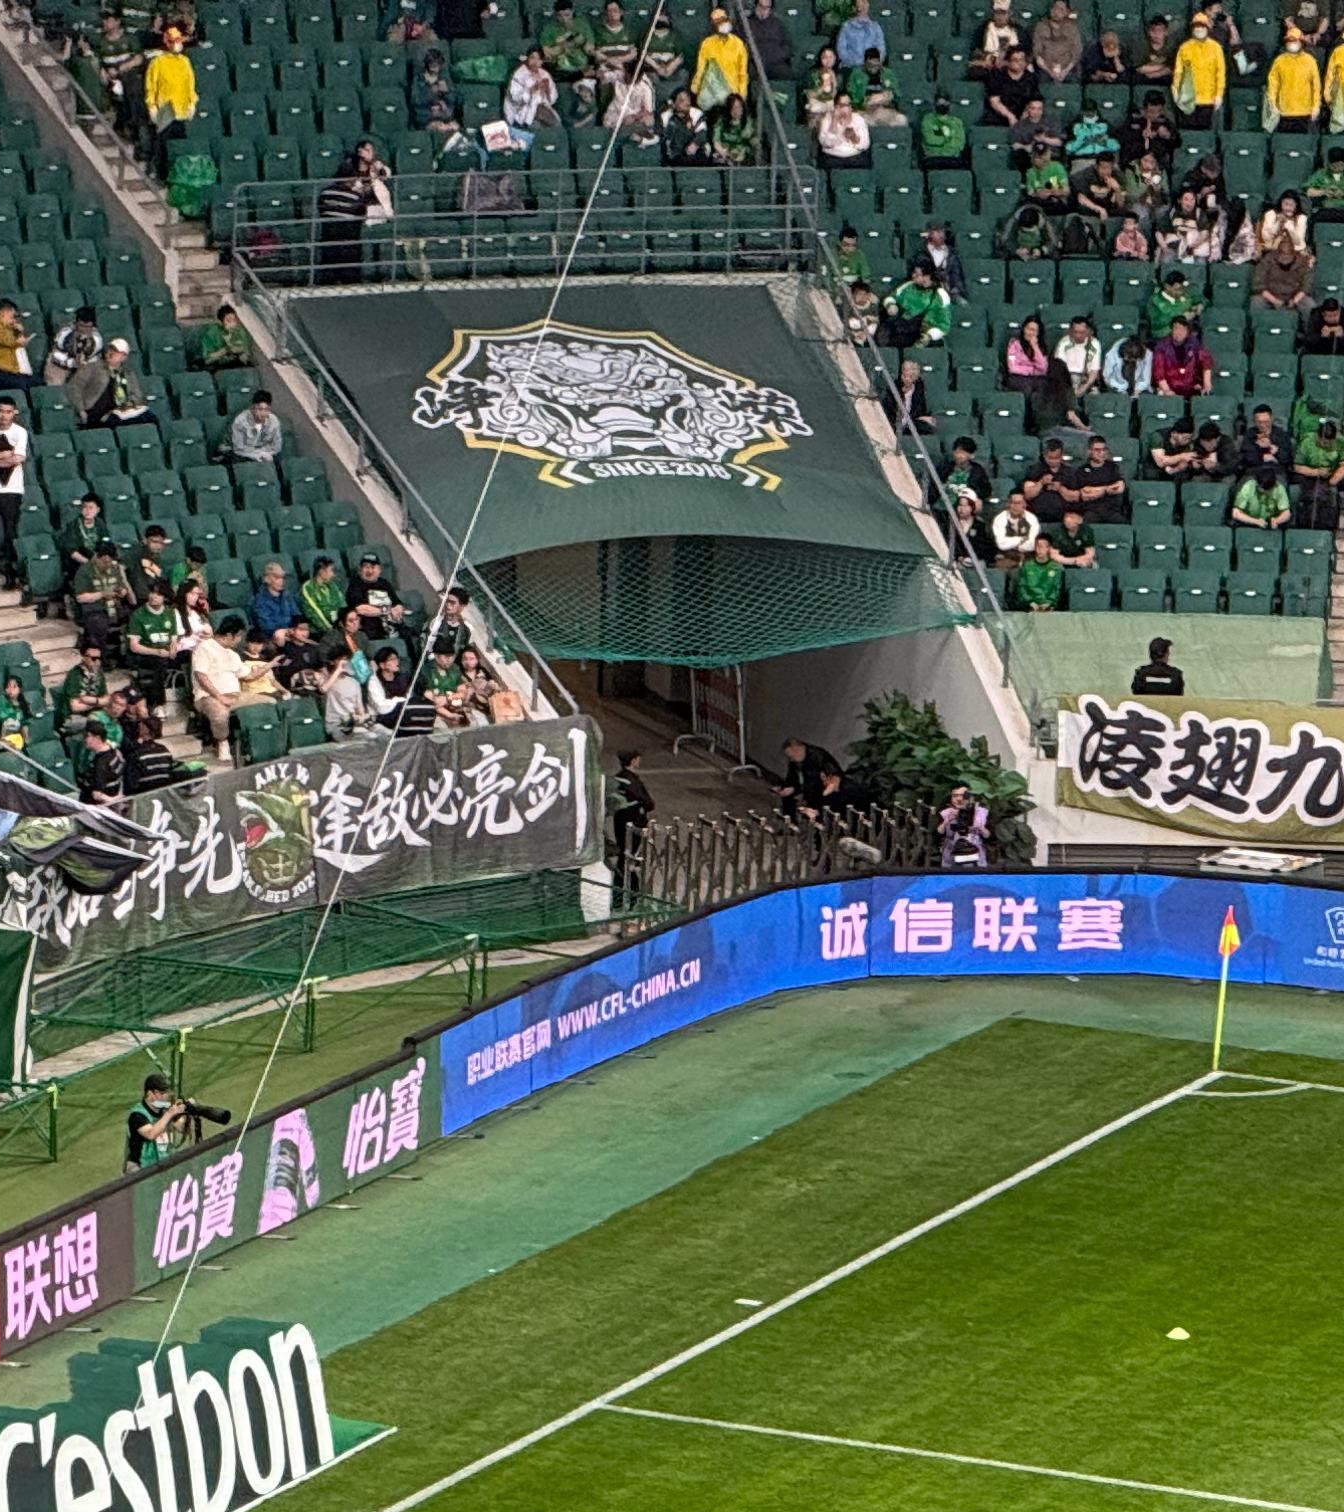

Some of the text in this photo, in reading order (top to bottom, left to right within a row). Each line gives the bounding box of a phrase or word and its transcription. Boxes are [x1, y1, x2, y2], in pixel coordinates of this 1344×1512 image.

[820, 896, 1124, 961] 诚信联赛
[466, 958, 701, 1086] 职业联赛官网 WWW.CFL-CHINA.CN
[3, 1210, 99, 1340] 联想
